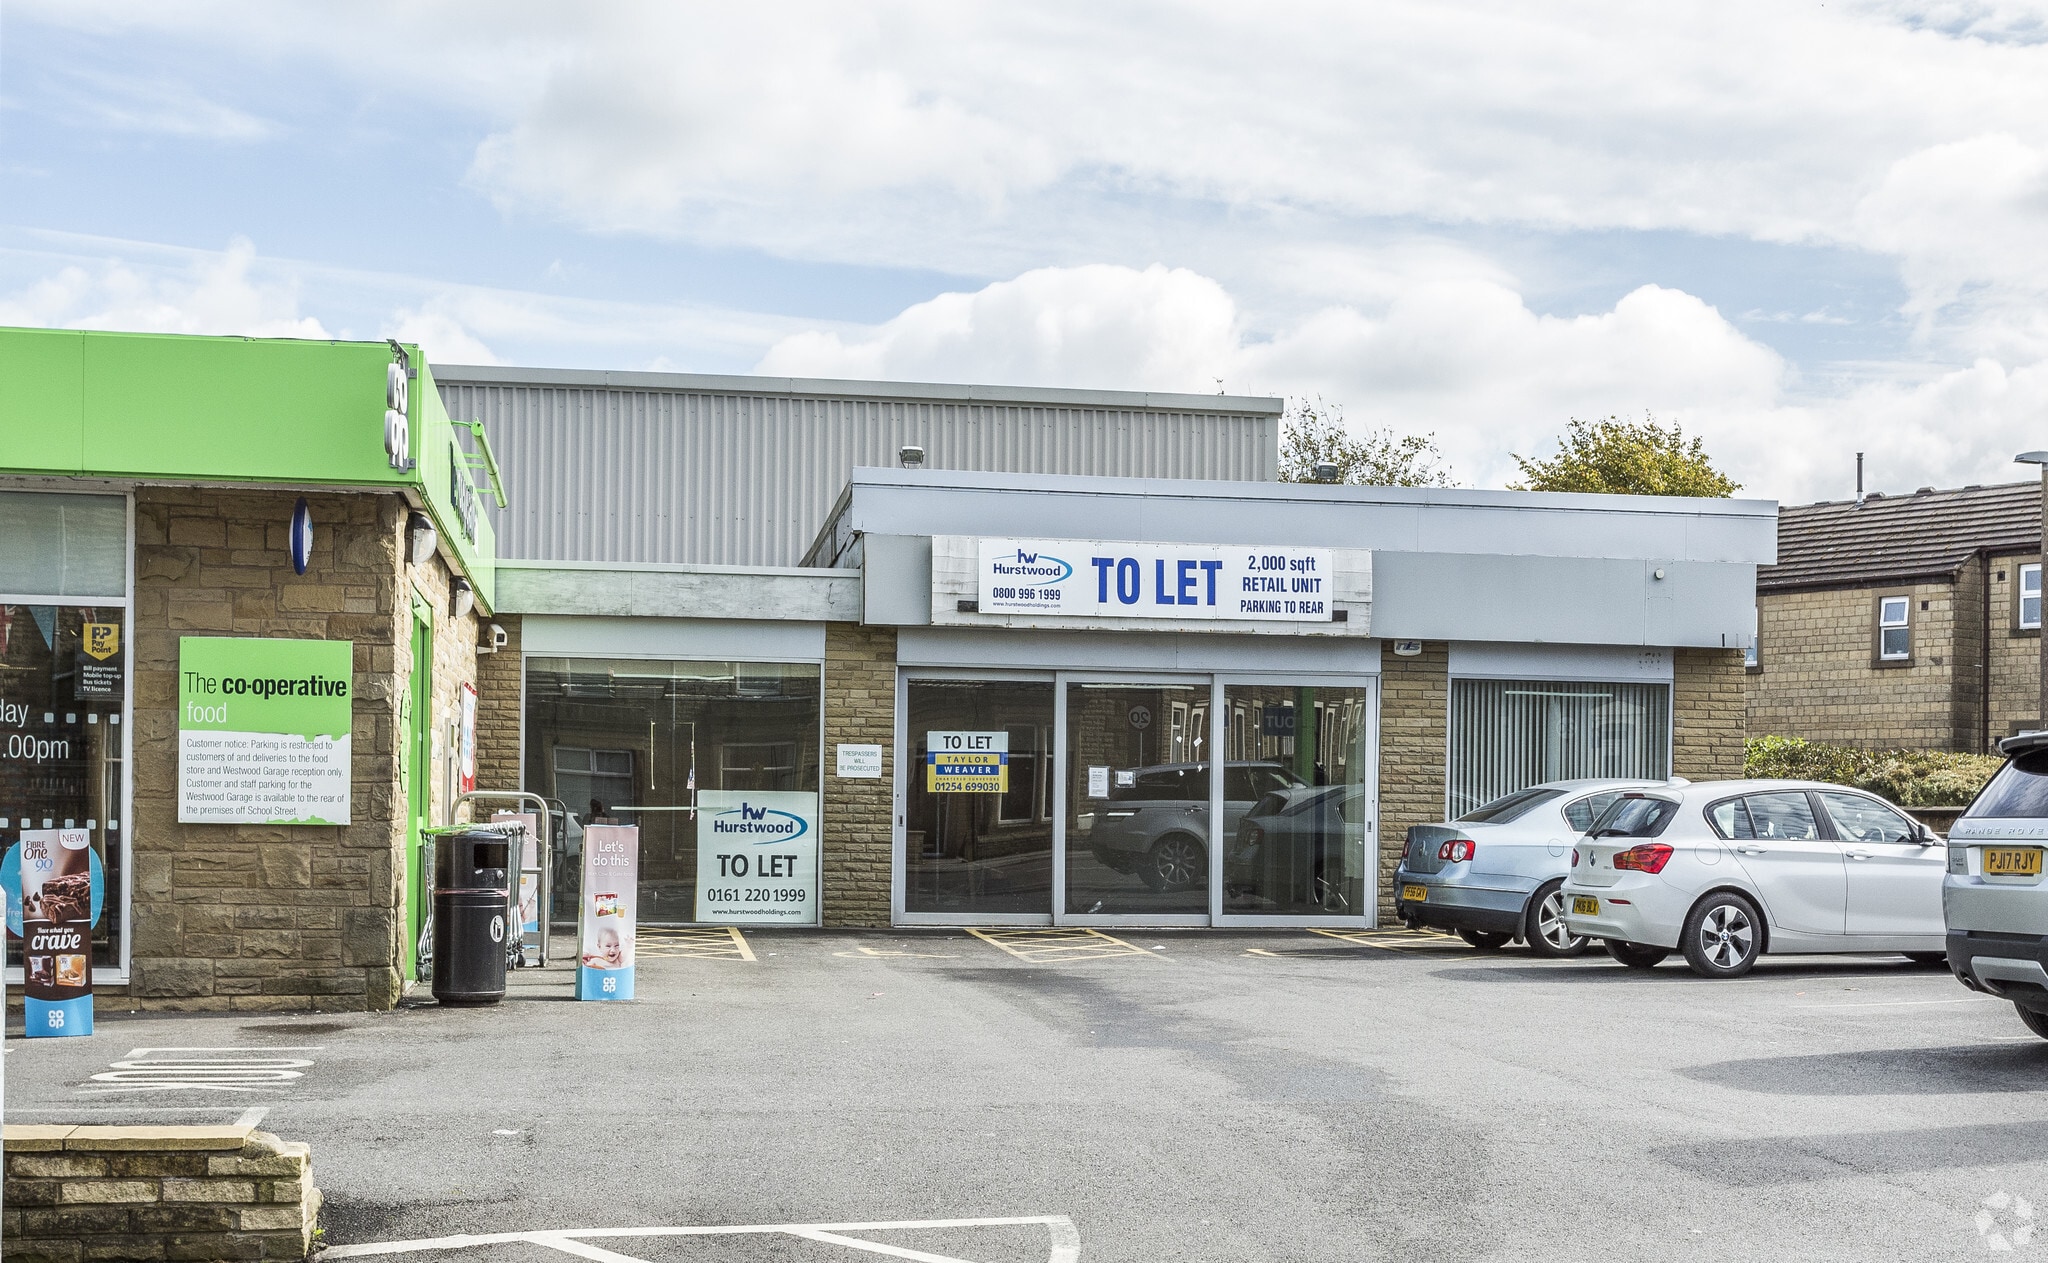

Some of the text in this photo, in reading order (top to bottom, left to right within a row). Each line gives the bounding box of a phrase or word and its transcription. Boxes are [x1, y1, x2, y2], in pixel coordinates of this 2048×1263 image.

[993, 563, 1061, 576] Hurstwood
[1248, 555, 1316, 574] 2,000 sqft
[1091, 557, 1223, 606] TO LET
[1243, 577, 1322, 593] RETAIL UNIT
[993, 587, 1061, 600] 0800 996 1999
[1240, 600, 1324, 614] PARKING TO REAR
[184, 672, 347, 700] The co-operative
[186, 701, 227, 723] food
[186, 738, 333, 751] Customer notice: Parking is restricted to
[943, 736, 992, 749] TO LET
[186, 753, 328, 763] customers of and deliveries to the food
[186, 766, 344, 778] store and Westwood Garage reception only.
[944, 766, 991, 774] WEAVER
[186, 779, 312, 790] Customer and staff parking for the
[935, 782, 1000, 792] 01254 699030
[186, 792, 224, 801] Westwood
[226, 793, 253, 803] Garage
[255, 793, 261, 801] is
[263, 793, 295, 802] available
[297, 794, 304, 802] to
[306, 794, 318, 802] the
[337, 794, 344, 802] of
[186, 806, 298, 817] the premises off School Street.
[714, 820, 793, 833] Hurstwood
[62, 834, 85, 842] NEW
[26, 841, 46, 849] FIBRE
[599, 840, 624, 852] Let's
[24, 848, 48, 860] One
[592, 854, 629, 866] do this
[1989, 852, 2035, 869] PJ17 RJY
[716, 854, 797, 877] TO LET
[707, 888, 806, 902] 0161 220 1999
[31, 934, 81, 950] crave
